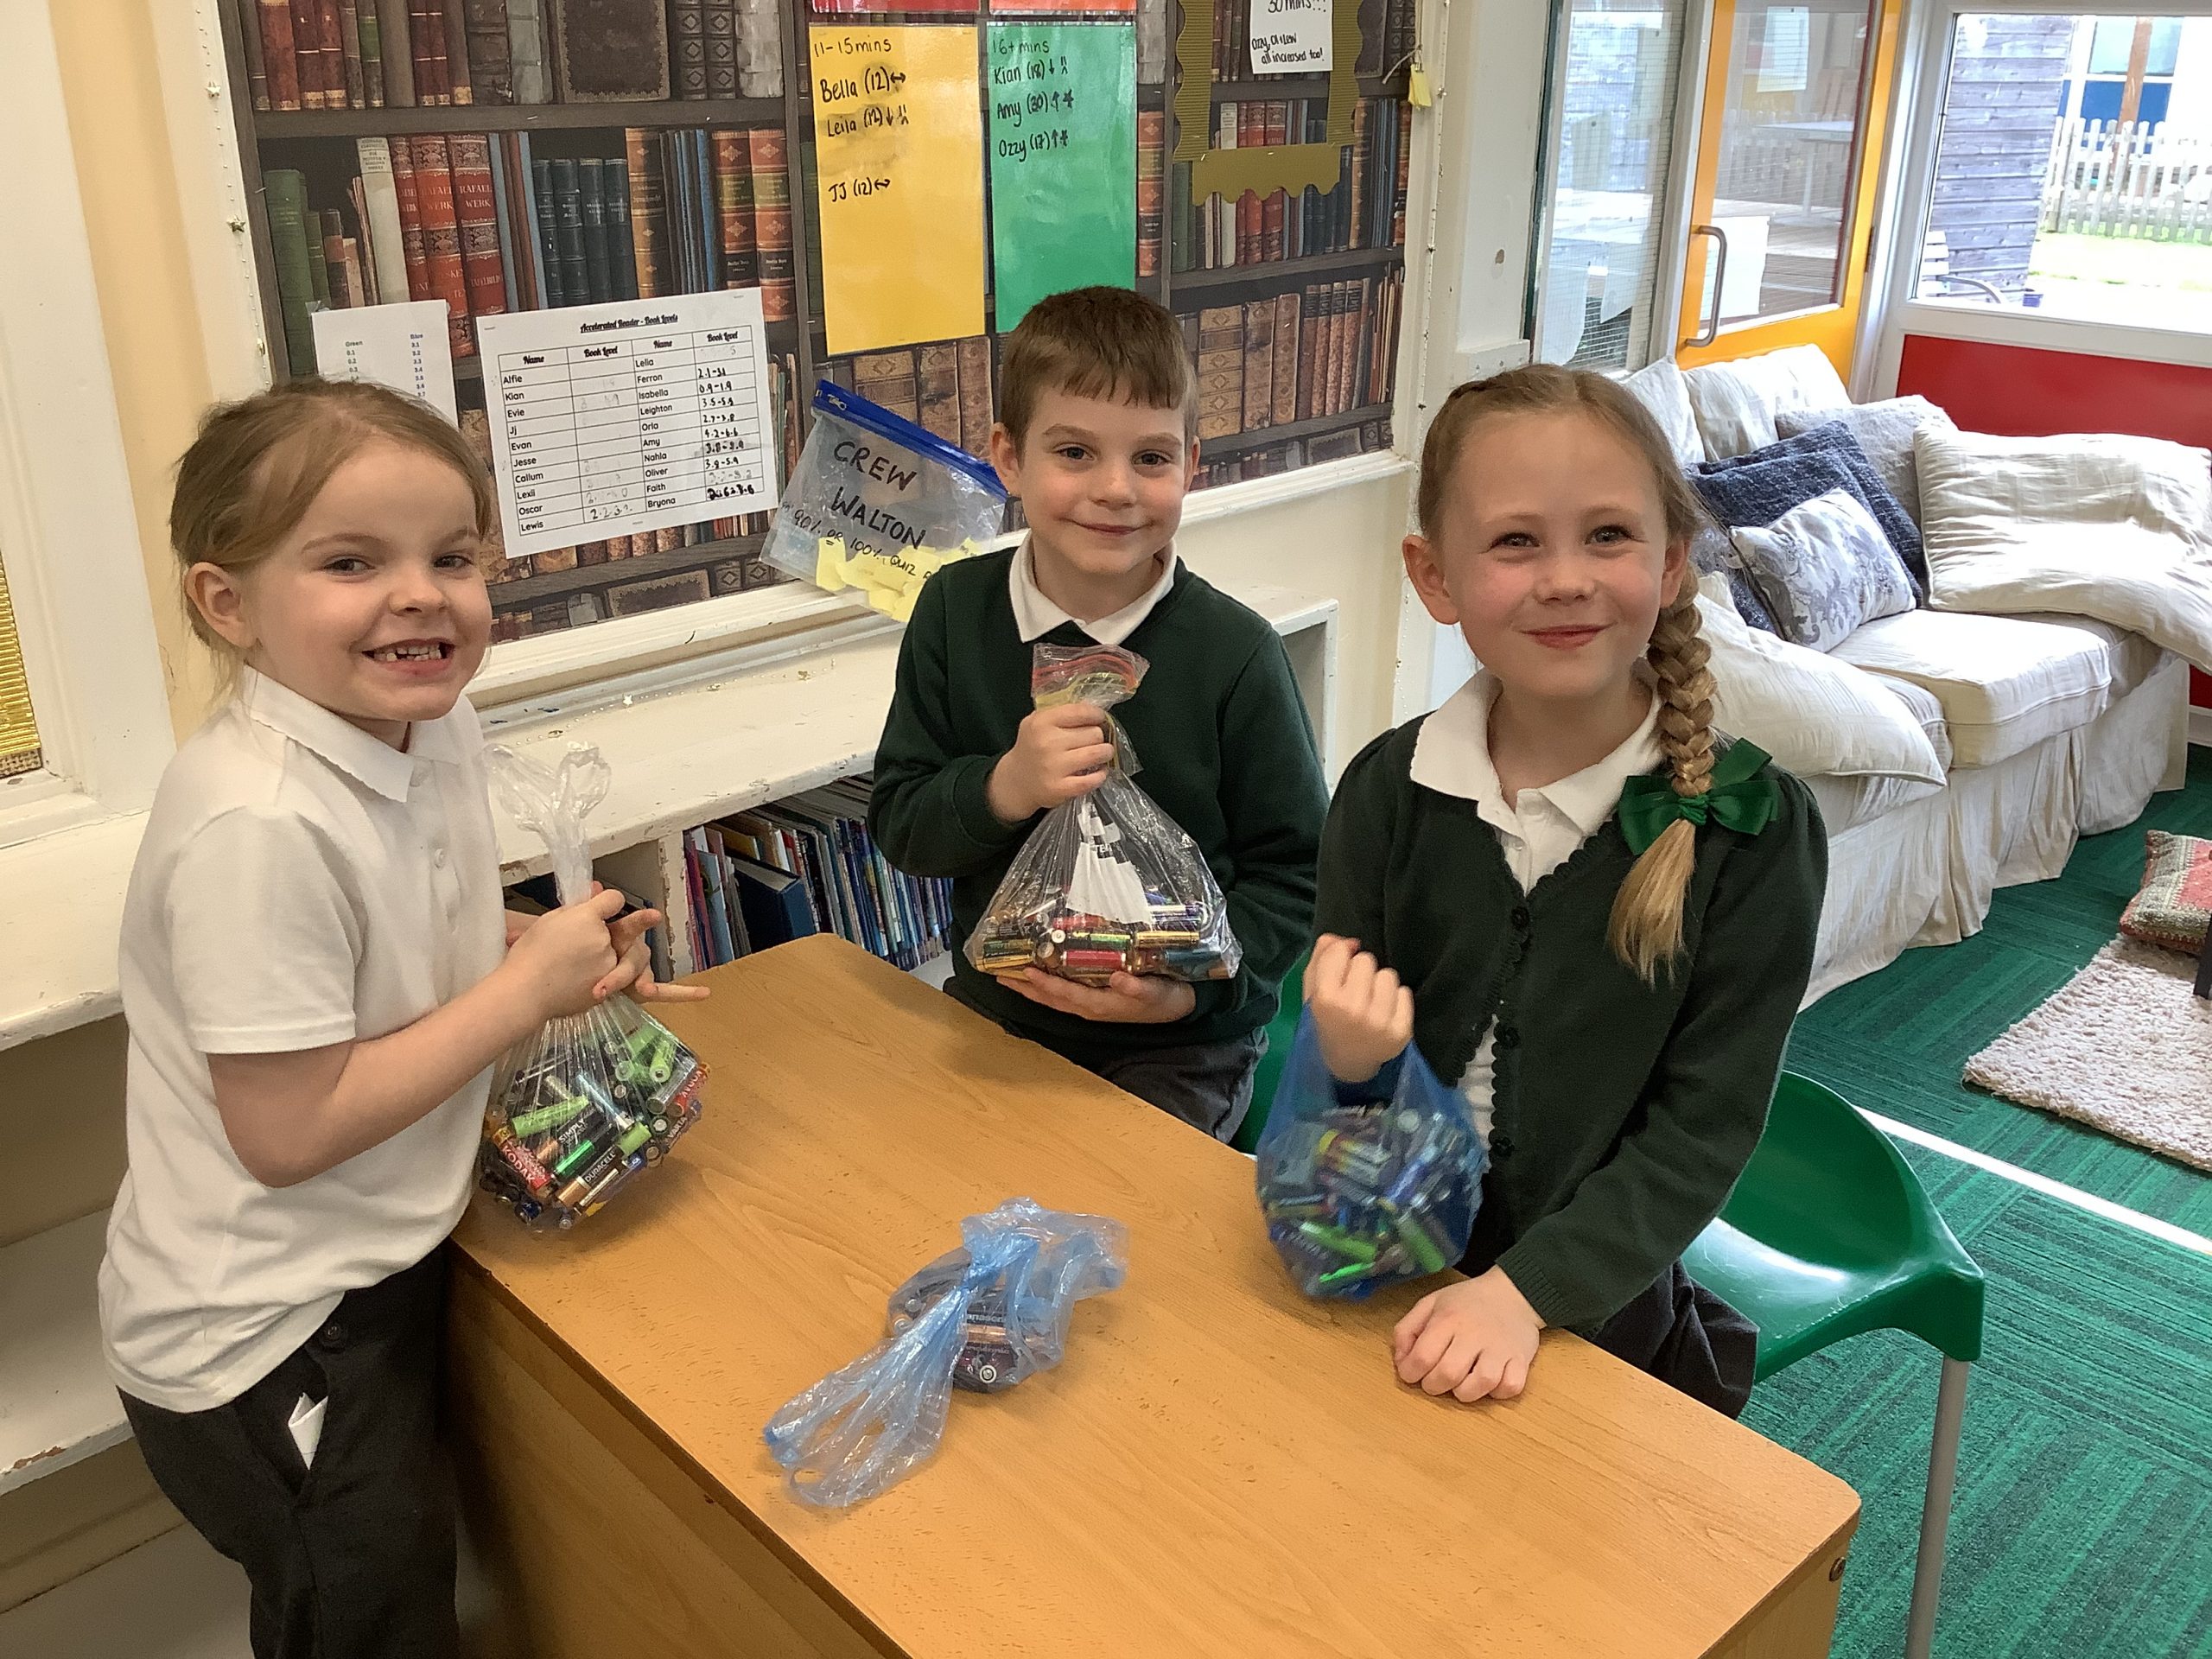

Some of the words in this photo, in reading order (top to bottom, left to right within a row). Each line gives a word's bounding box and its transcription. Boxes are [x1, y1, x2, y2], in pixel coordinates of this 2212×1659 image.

[1019, 40, 1050, 54] mins
[994, 66, 1021, 85] Kian
[819, 79, 859, 103] Bella
[997, 101, 1022, 128] Amy
[827, 115, 857, 137] Leila
[998, 138, 1027, 162] Ozzy
[828, 181, 849, 202] JJ
[653, 340, 673, 349] Name
[707, 333, 723, 343] Book
[523, 354, 544, 365] Name
[583, 347, 601, 358] Book
[602, 346, 618, 358] Level
[503, 374, 523, 385] Alfie
[637, 373, 663, 384] Ferron
[505, 391, 525, 401] Kian
[639, 388, 669, 400] Isabella
[507, 408, 525, 418] Evie
[639, 404, 673, 416] Leighton
[641, 422, 659, 431] Orla
[511, 441, 532, 451] Evan
[643, 438, 661, 447] Amy
[513, 457, 537, 467] Jesse
[644, 452, 667, 461] Nahla
[645, 467, 668, 477] Oliver
[833, 441, 917, 491] CREW
[515, 473, 543, 484] Callum
[646, 482, 666, 493] Faith
[518, 505, 543, 516] Oscar
[831, 486, 926, 550] WALTON
[520, 520, 544, 531] Lewis
[826, 529, 843, 543] OR
[890, 555, 917, 576] QUIZ
[558, 1117, 587, 1144] SIMPLY
[503, 1145, 536, 1185] KODAK
[584, 1150, 617, 1184] DURACELL
